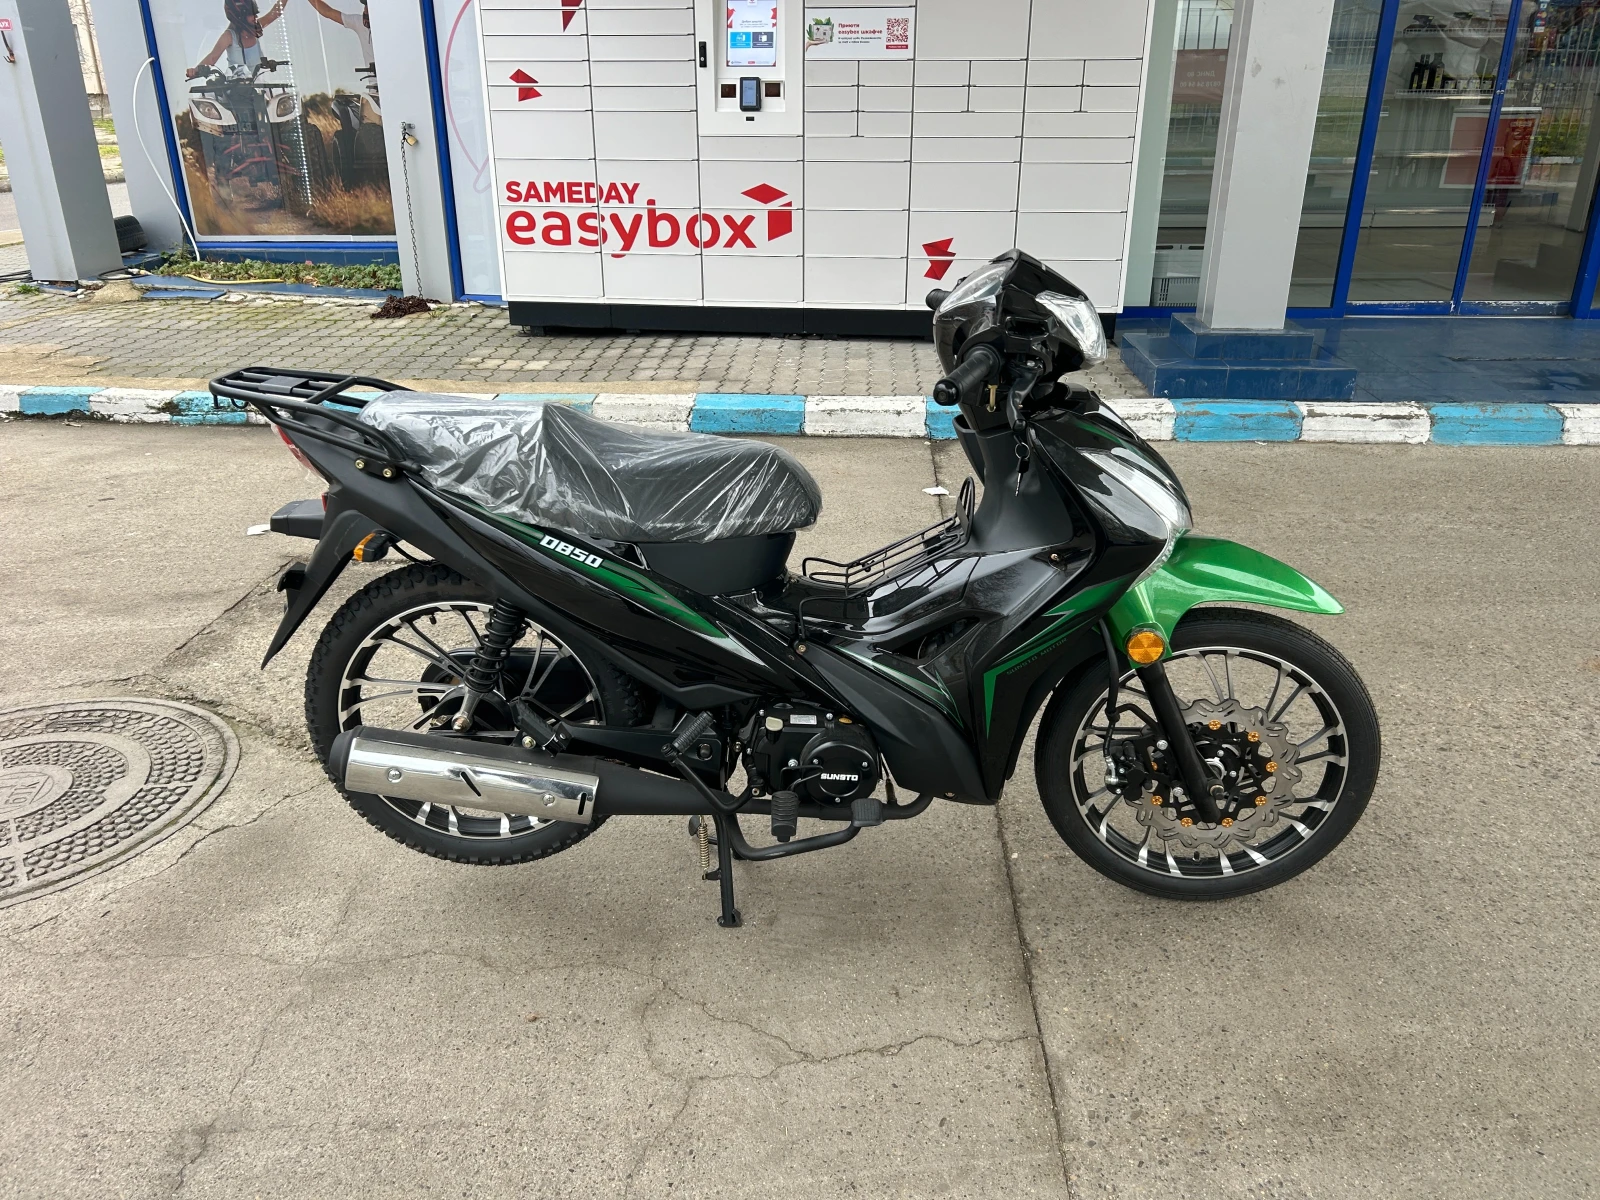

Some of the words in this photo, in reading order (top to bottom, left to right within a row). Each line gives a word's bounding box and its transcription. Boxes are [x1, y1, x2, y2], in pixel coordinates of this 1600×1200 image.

[505, 180, 641, 204] SAMEDAY
[505, 198, 758, 259] easybox
[539, 534, 603, 568] DB50
[820, 772, 859, 782] SUNSTO
